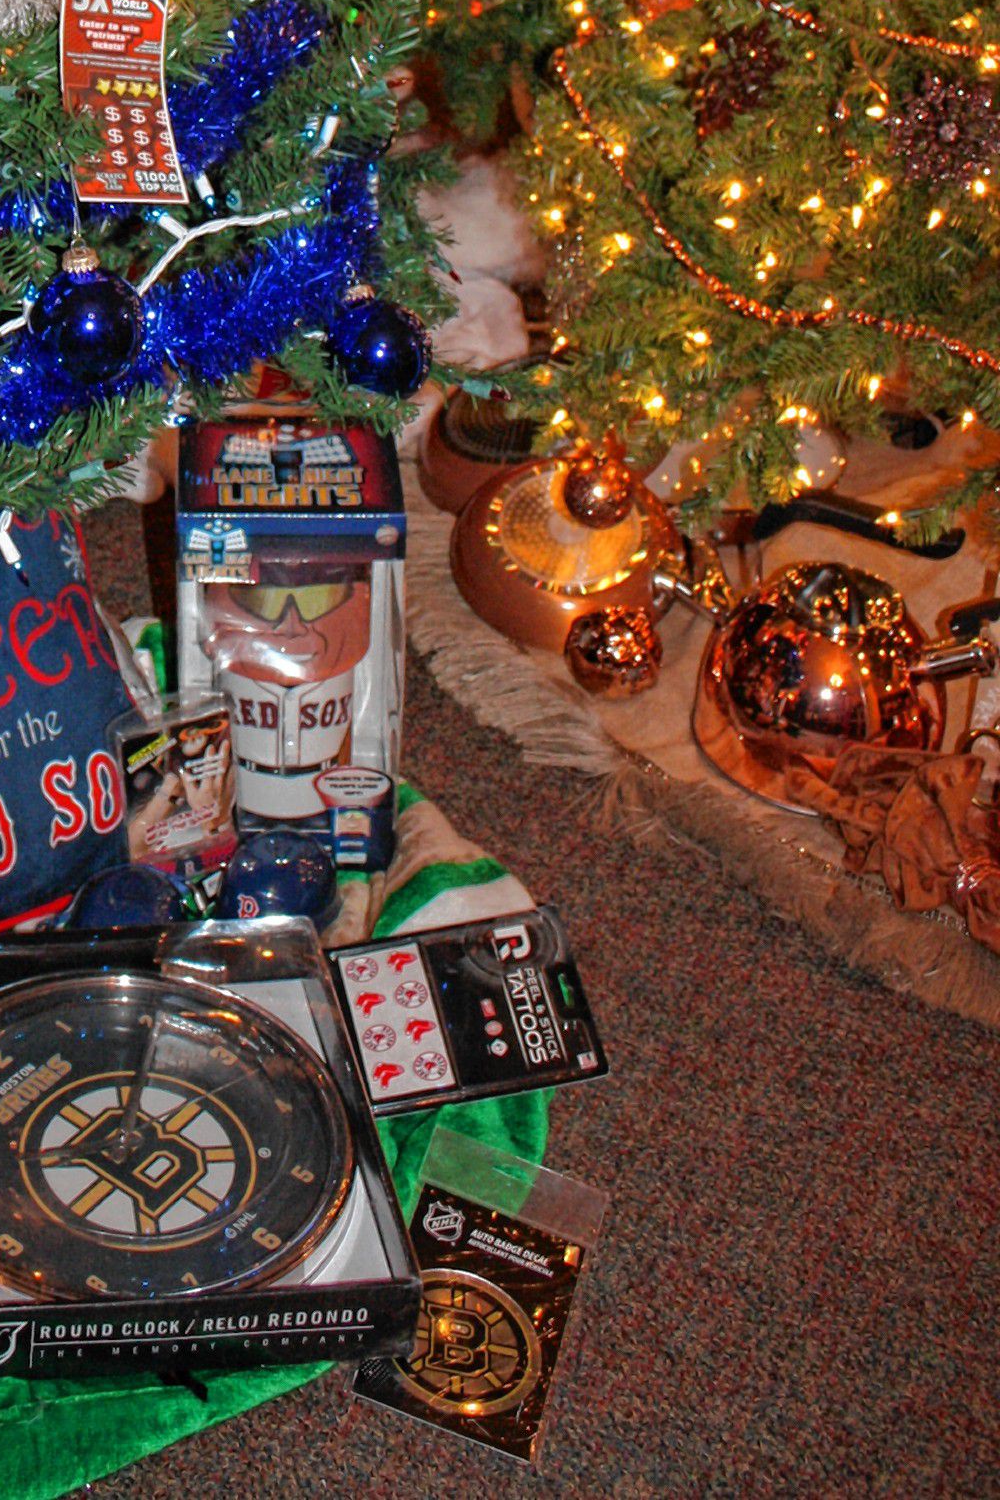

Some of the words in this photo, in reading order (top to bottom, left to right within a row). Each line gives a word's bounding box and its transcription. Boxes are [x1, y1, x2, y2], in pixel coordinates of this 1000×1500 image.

[79, 19, 105, 30] Enter
[107, 22, 120, 31] to
[121, 24, 141, 34] win
[140, 183, 160, 192] TOP
[212, 467, 275, 484] GAME
[302, 467, 364, 484] NIGHT
[217, 483, 363, 507] LIGHTS
[299, 693, 352, 730] SOX
[17, 709, 63, 749] the
[506, 967, 550, 1065] TATTOOS
[524, 967, 542, 1003] PEEL
[538, 1016, 562, 1061] STICK
[290, 1164, 316, 1185] 5
[232, 1211, 258, 1232] NHL
[430, 1215, 458, 1230] NHL
[251, 1226, 283, 1251] 6
[469, 1228, 495, 1244] AUTO
[494, 1237, 524, 1255] BADGE
[521, 1248, 552, 1267] DECAL
[38, 1322, 114, 1340] ROUND
[120, 1317, 180, 1336] CLOCK
[202, 1314, 260, 1332] RELOJ
[267, 1307, 369, 1328] REDONDO
[38, 1348, 84, 1359] THE
[111, 1342, 217, 1356] MEMORY
[242, 1332, 365, 1349] COMPANY
